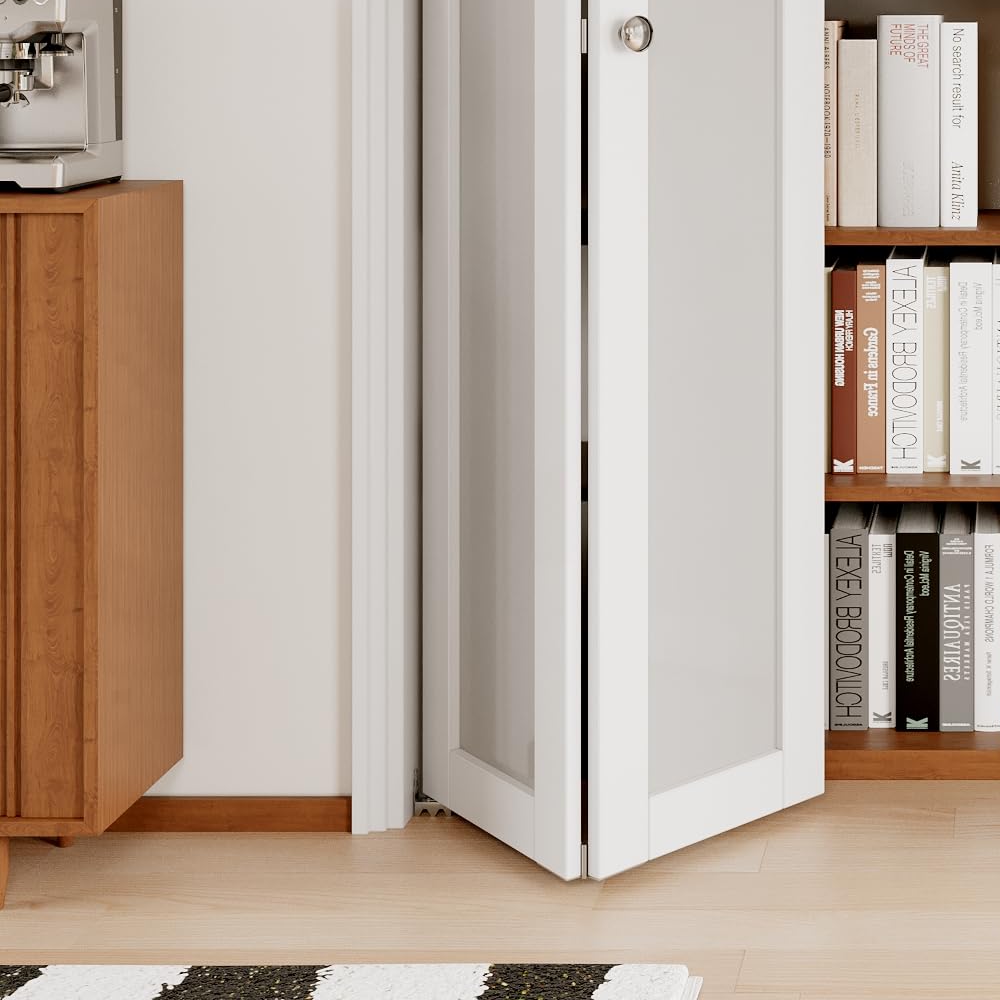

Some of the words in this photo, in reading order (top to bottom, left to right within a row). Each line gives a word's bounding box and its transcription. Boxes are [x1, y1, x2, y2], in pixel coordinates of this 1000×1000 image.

[890, 24, 902, 56] FUTURE
[904, 24, 915, 50] MINDS
[917, 24, 928, 40] THE
[952, 28, 964, 43] No
[904, 51, 915, 62] OF
[917, 41, 928, 68] GREAT
[952, 46, 964, 80] search
[952, 83, 964, 112] result
[952, 114, 964, 128] for
[952, 161, 964, 190] Anita
[952, 193, 964, 221] Klinz
